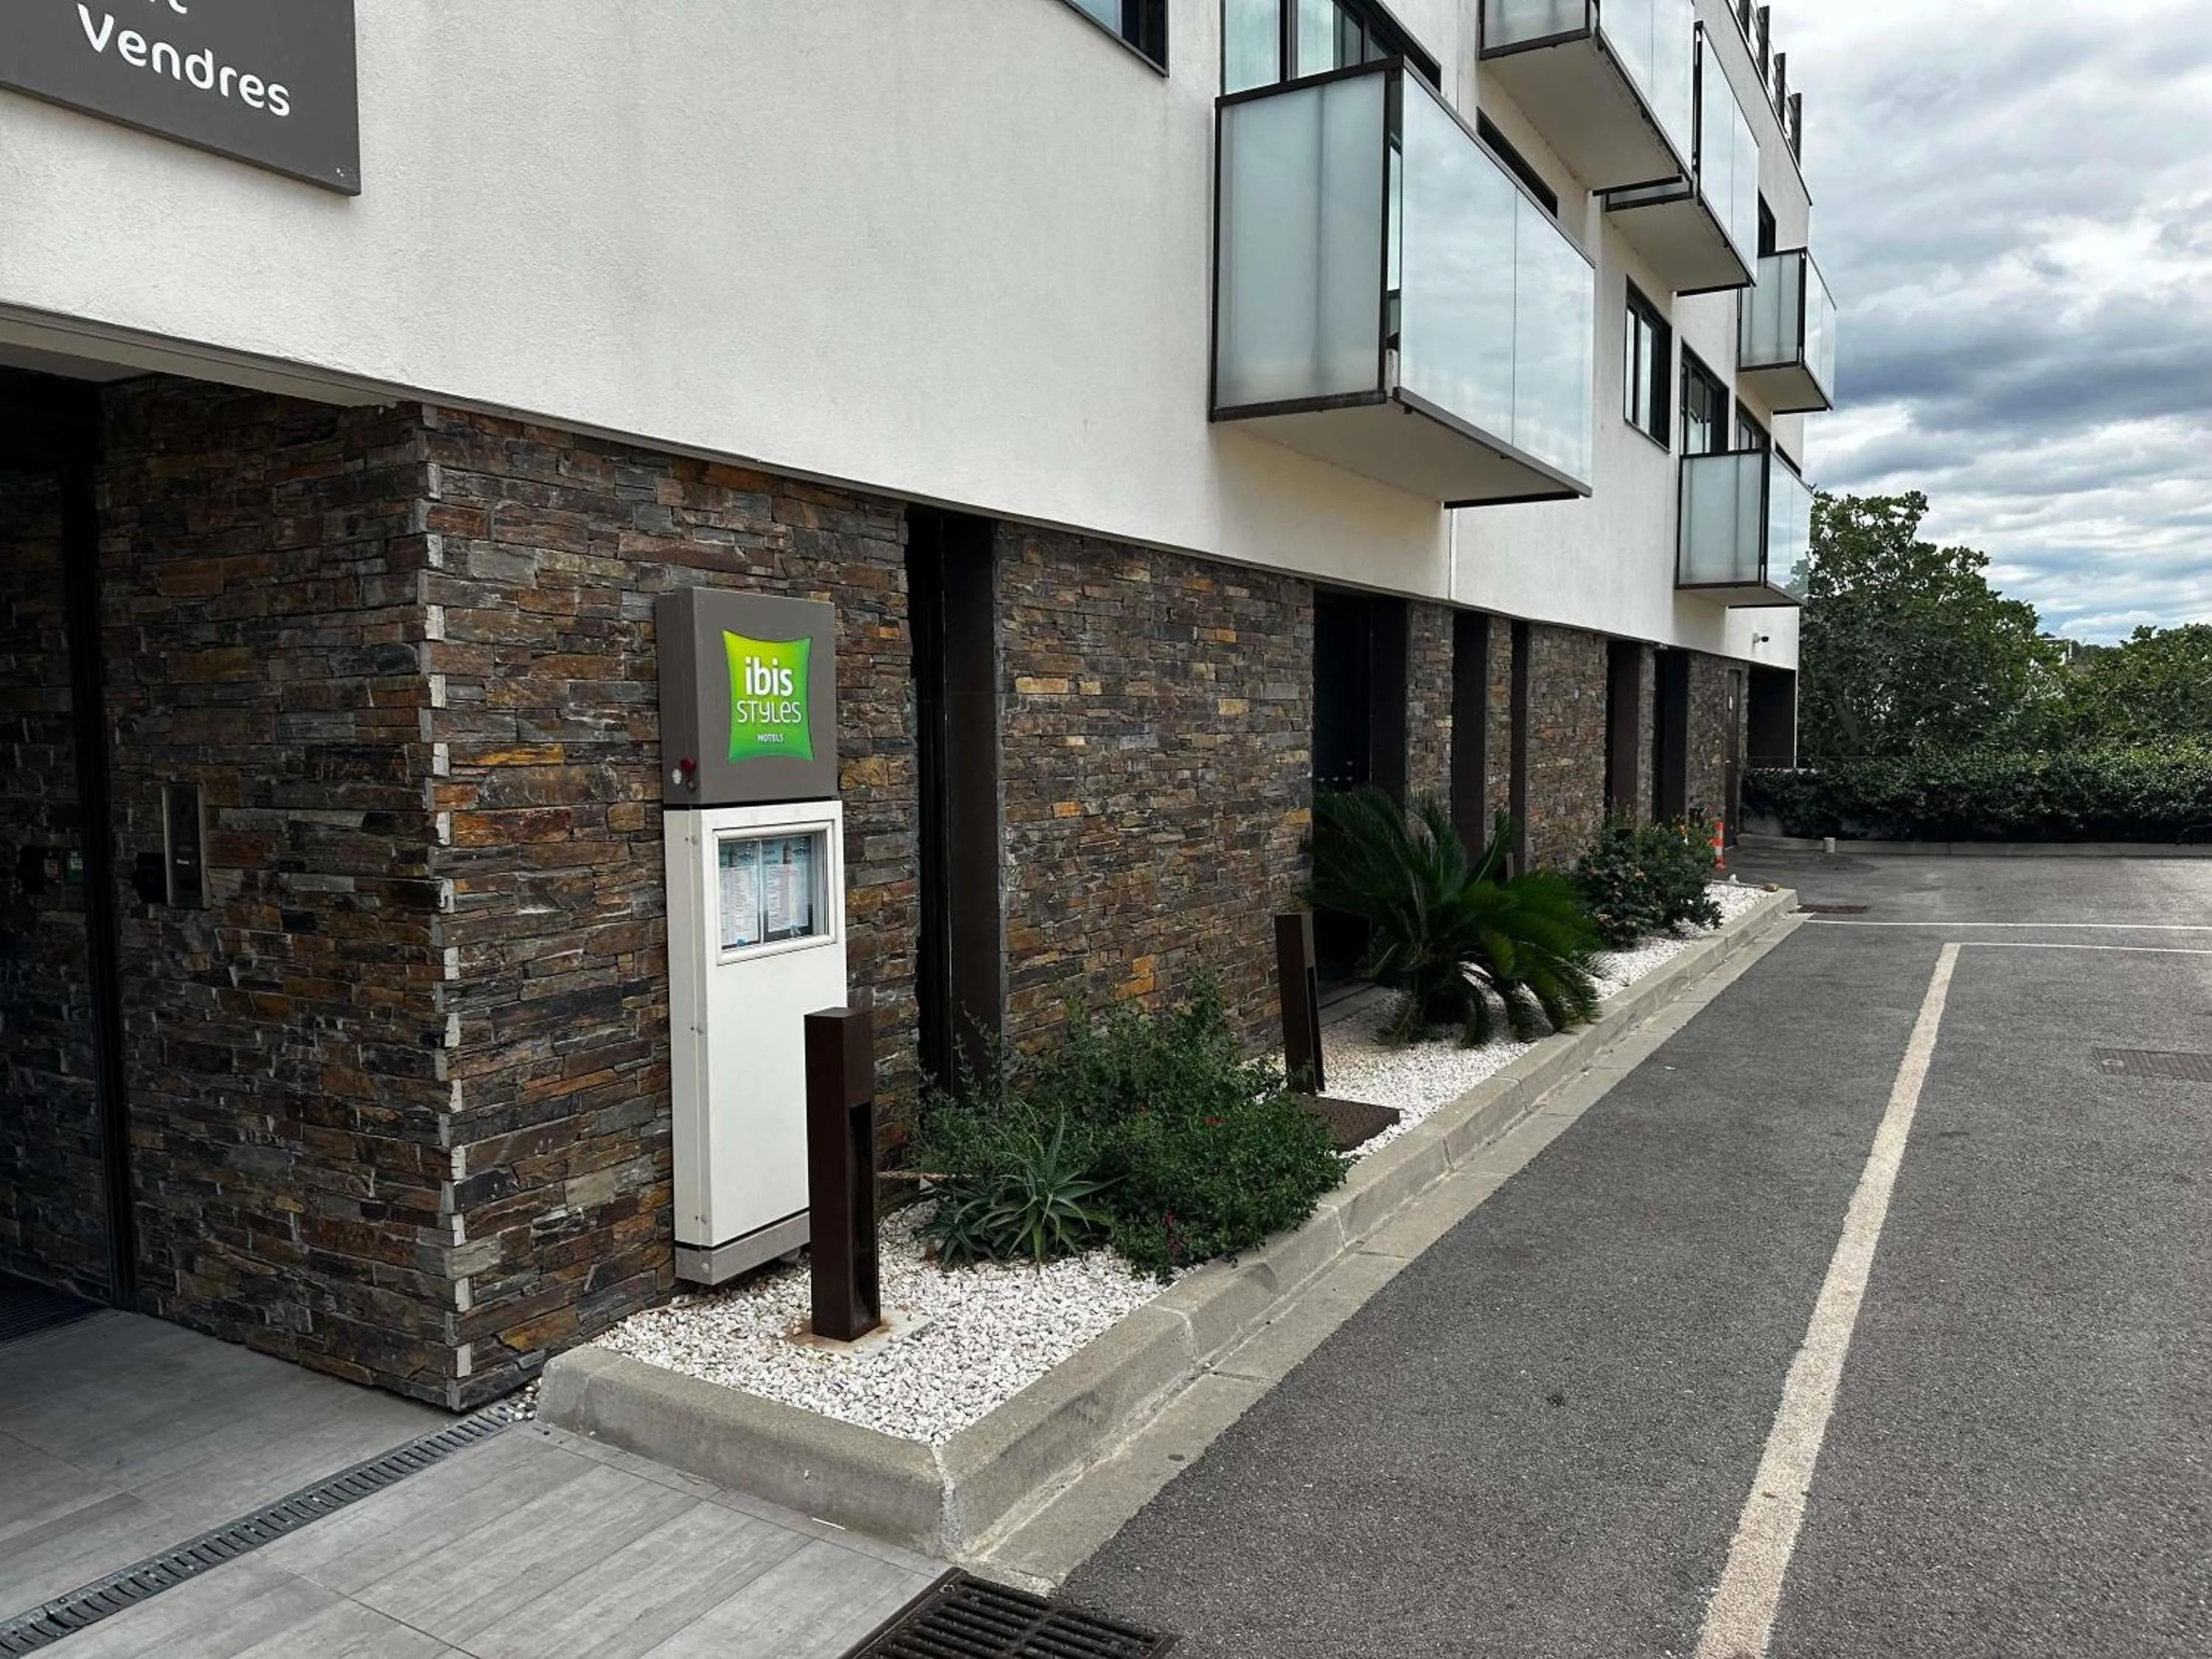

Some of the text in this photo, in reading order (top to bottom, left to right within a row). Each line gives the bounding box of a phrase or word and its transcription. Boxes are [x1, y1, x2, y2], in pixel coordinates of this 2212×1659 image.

[77, 3, 291, 116] Vendres
[744, 656, 793, 697] ibis
[757, 733, 785, 743] HOTELS
